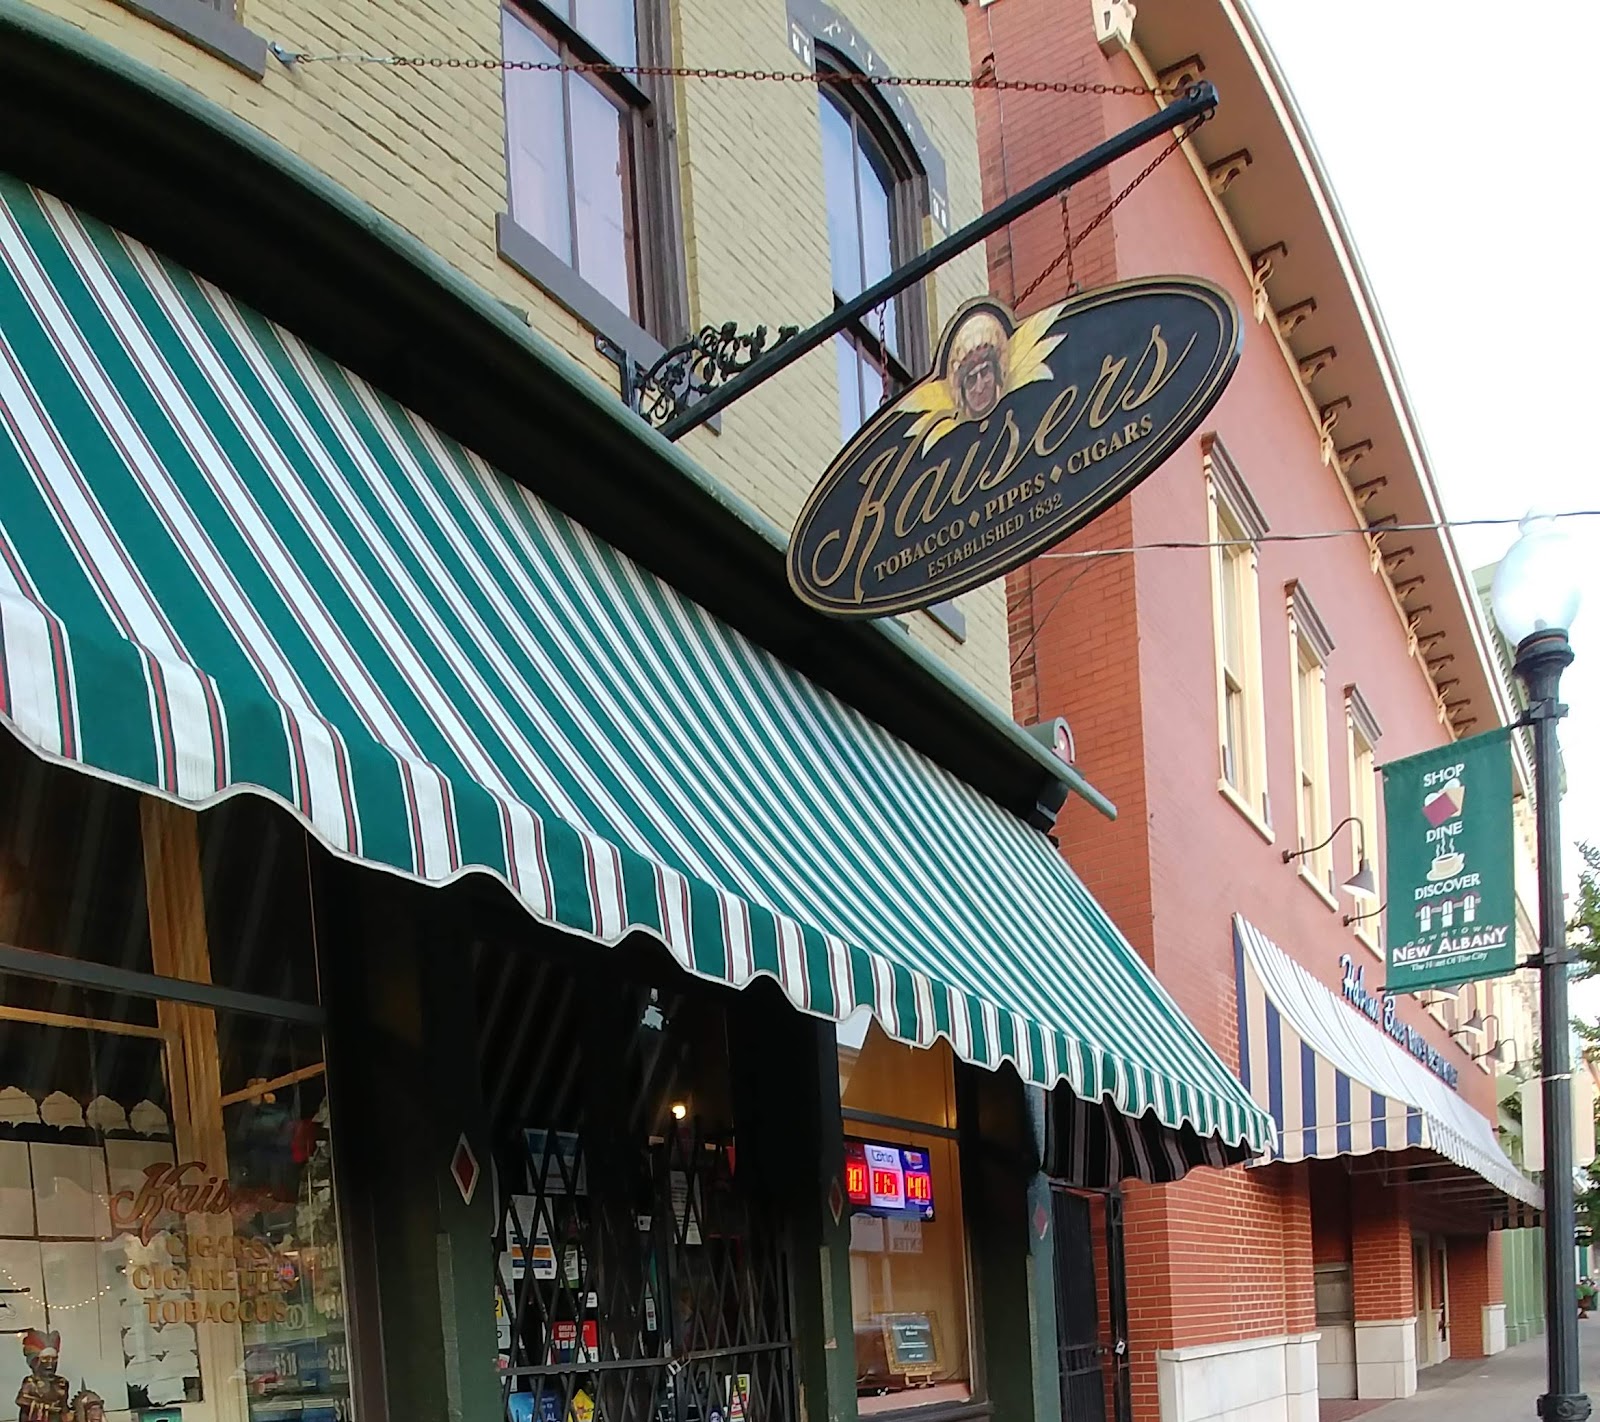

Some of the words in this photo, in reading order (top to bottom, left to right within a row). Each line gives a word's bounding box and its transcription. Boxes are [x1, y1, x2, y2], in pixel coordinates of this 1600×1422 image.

[873, 518, 965, 582] TOBACCO
[984, 473, 1046, 522] PIPES
[1066, 413, 1154, 477] CIGARS
[927, 512, 1025, 579] ESTABLISHED
[1028, 492, 1064, 524] 1832
[1423, 763, 1465, 788] SHOP
[1426, 821, 1464, 843] DINE
[1414, 873, 1482, 901] DISCOVER
[1406, 925, 1494, 948] DOWNTOWN
[1411, 962, 1425, 971] The
[1457, 954, 1471, 964] The
[1471, 951, 1488, 962] City
[165, 1236, 267, 1260] CIGARS
[133, 1265, 297, 1291] CIGARETTES
